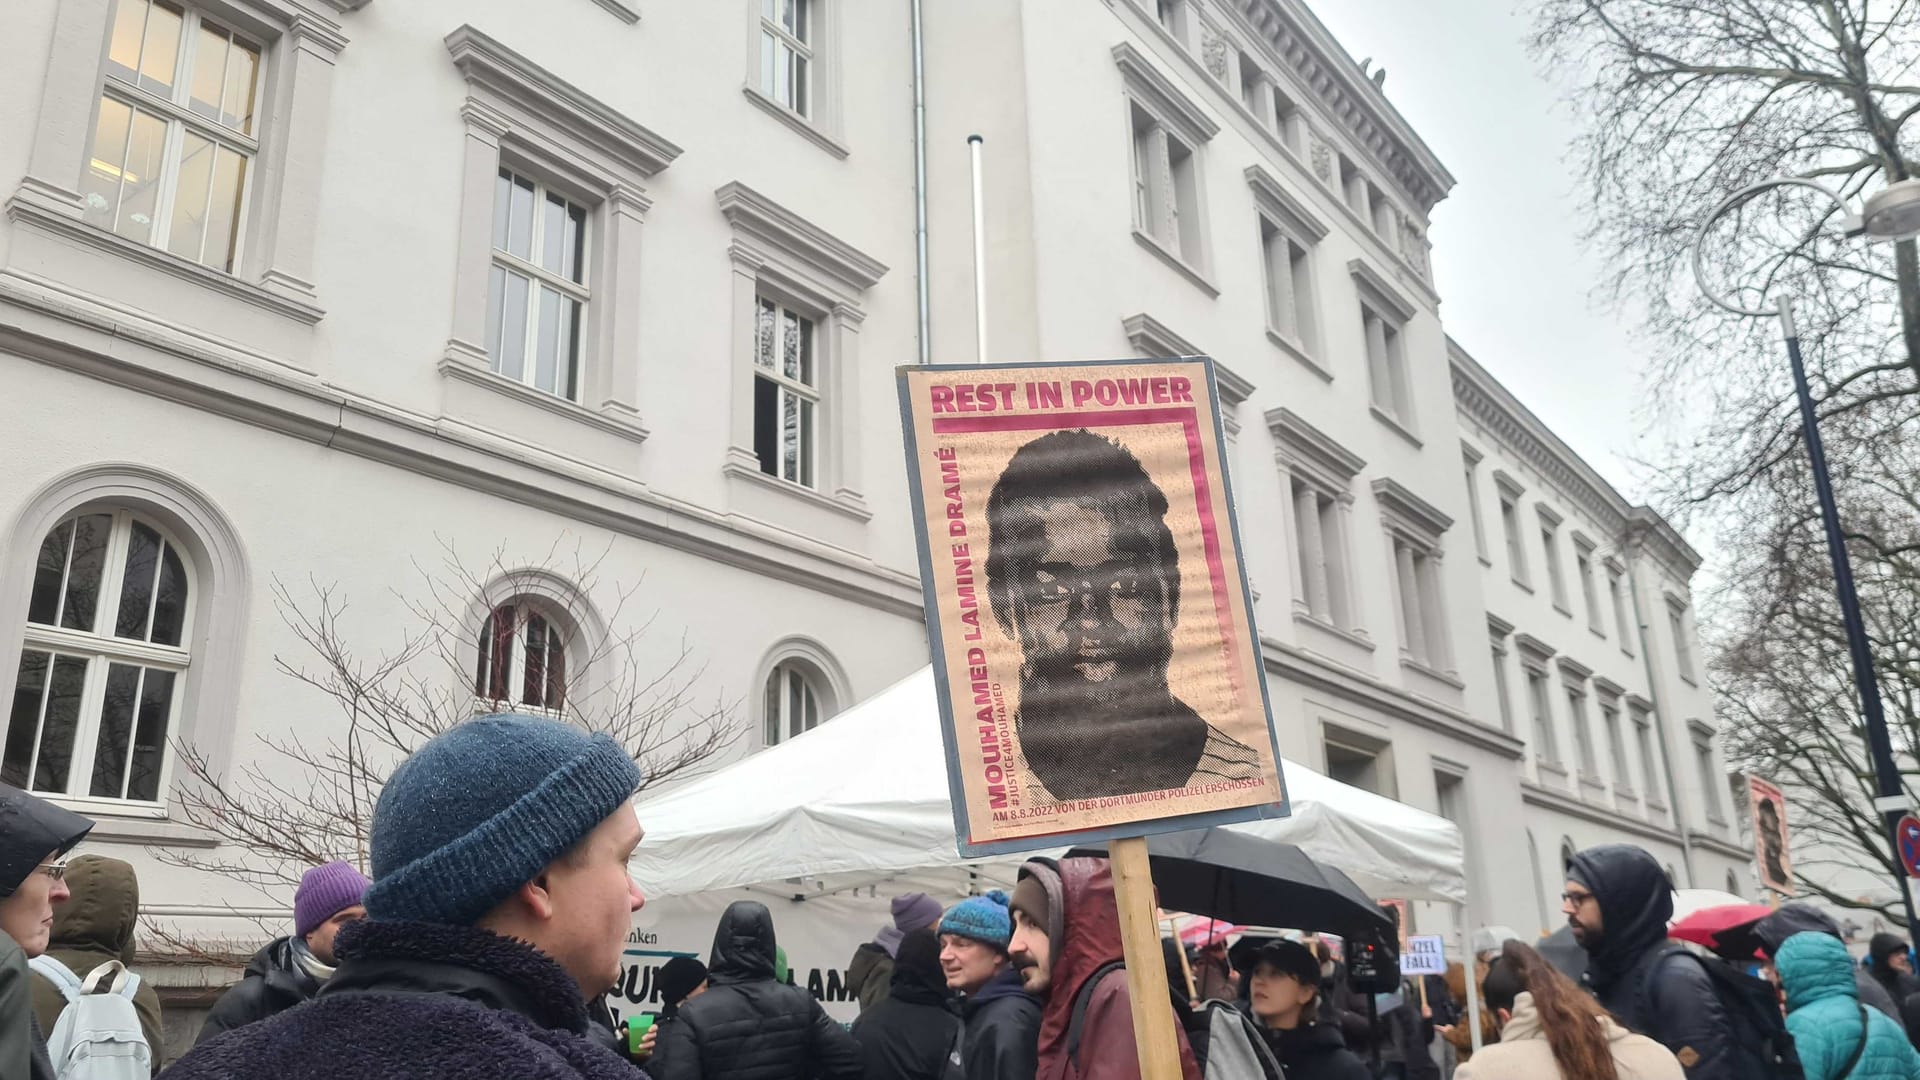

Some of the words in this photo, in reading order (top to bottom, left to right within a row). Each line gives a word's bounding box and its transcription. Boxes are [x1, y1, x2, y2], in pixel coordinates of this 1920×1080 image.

[930, 383, 1016, 413] REST
[1025, 381, 1064, 410] IN
[1070, 376, 1194, 407] POWER
[934, 447, 967, 537] DRAMÉ
[952, 543, 982, 641] LAMINE
[967, 648, 1008, 809] MOUHAMED
[993, 683, 1020, 806] #JUSTICE4MOUHAMED
[993, 811, 1008, 822] AM
[1011, 806, 1052, 820] 8.8.2022
[1055, 802, 1076, 815] VON
[1079, 800, 1098, 811] DER
[1100, 791, 1166, 809] DORTMUNDER
[1168, 786, 1204, 799] POLIZEI
[1206, 777, 1265, 794] ERSCHOSSEN
[625, 927, 657, 945] nken
